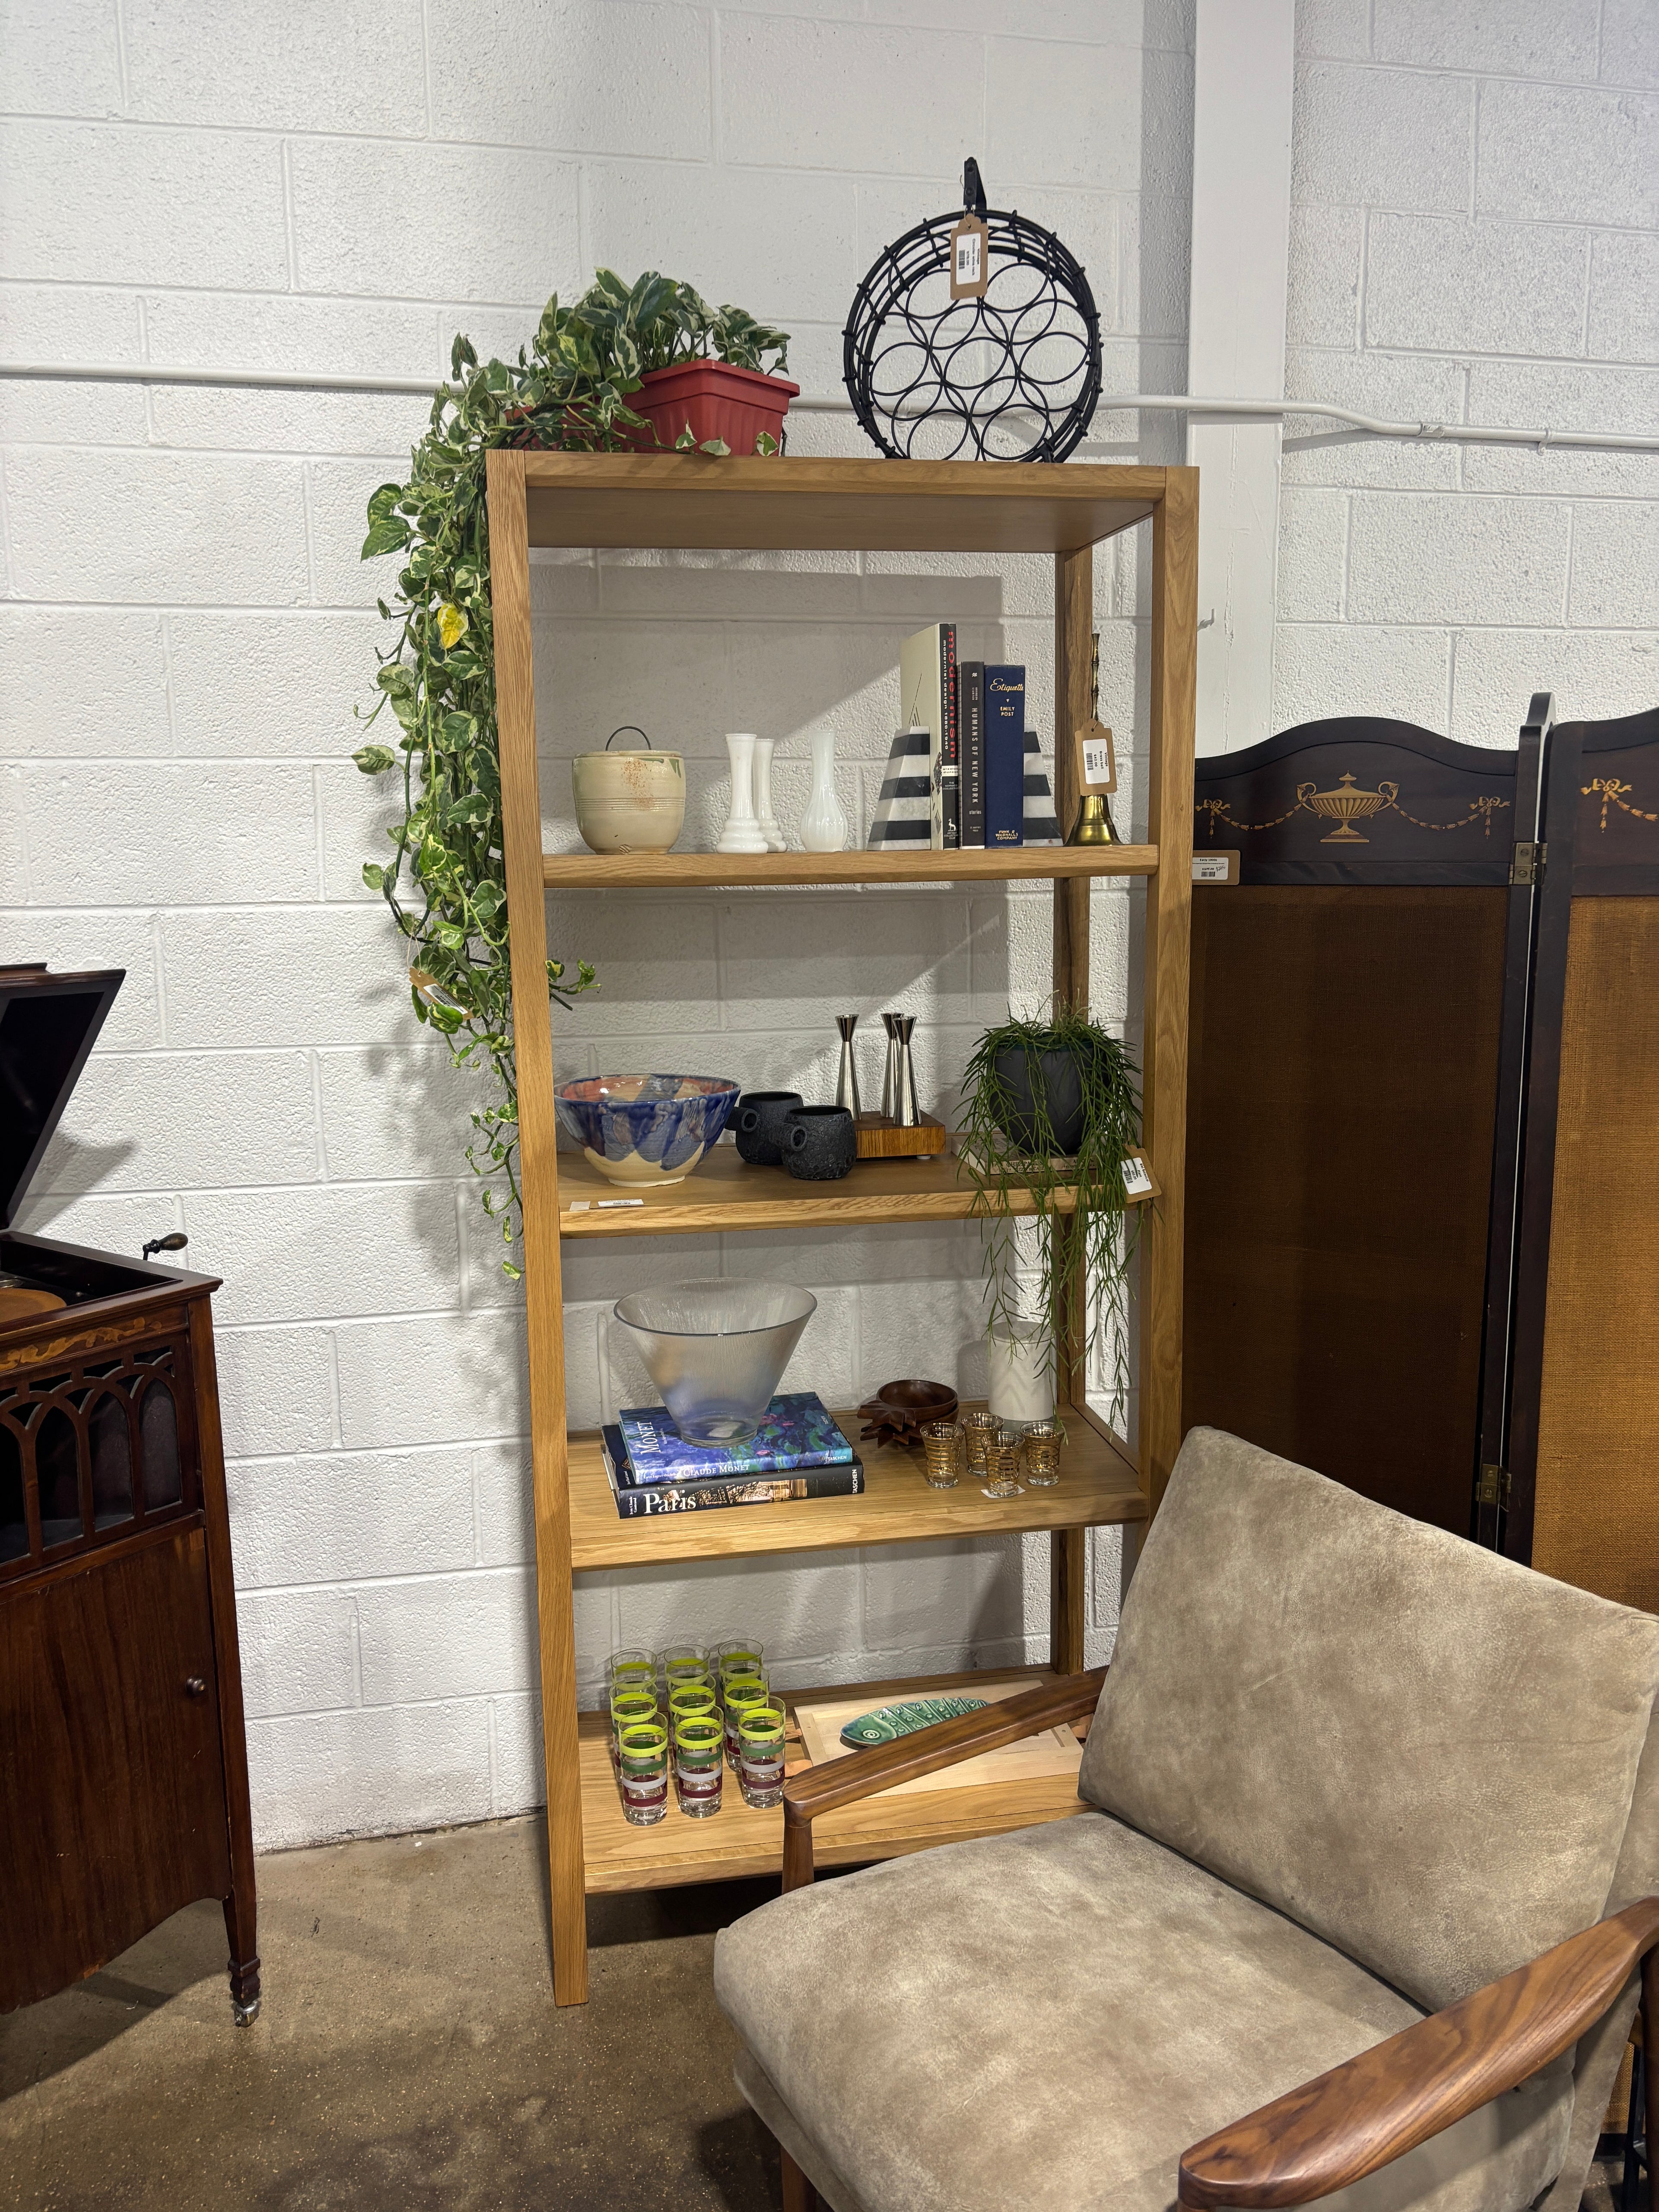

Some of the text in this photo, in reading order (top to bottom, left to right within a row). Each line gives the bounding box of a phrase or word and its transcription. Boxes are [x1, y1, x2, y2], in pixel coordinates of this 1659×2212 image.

[948, 631, 956, 759] modernism
[972, 746, 978, 756] OF
[636, 1421, 661, 1455] MONET
[683, 1465, 750, 1476] CLAUDE MONET
[643, 1489, 696, 1514] Paris
